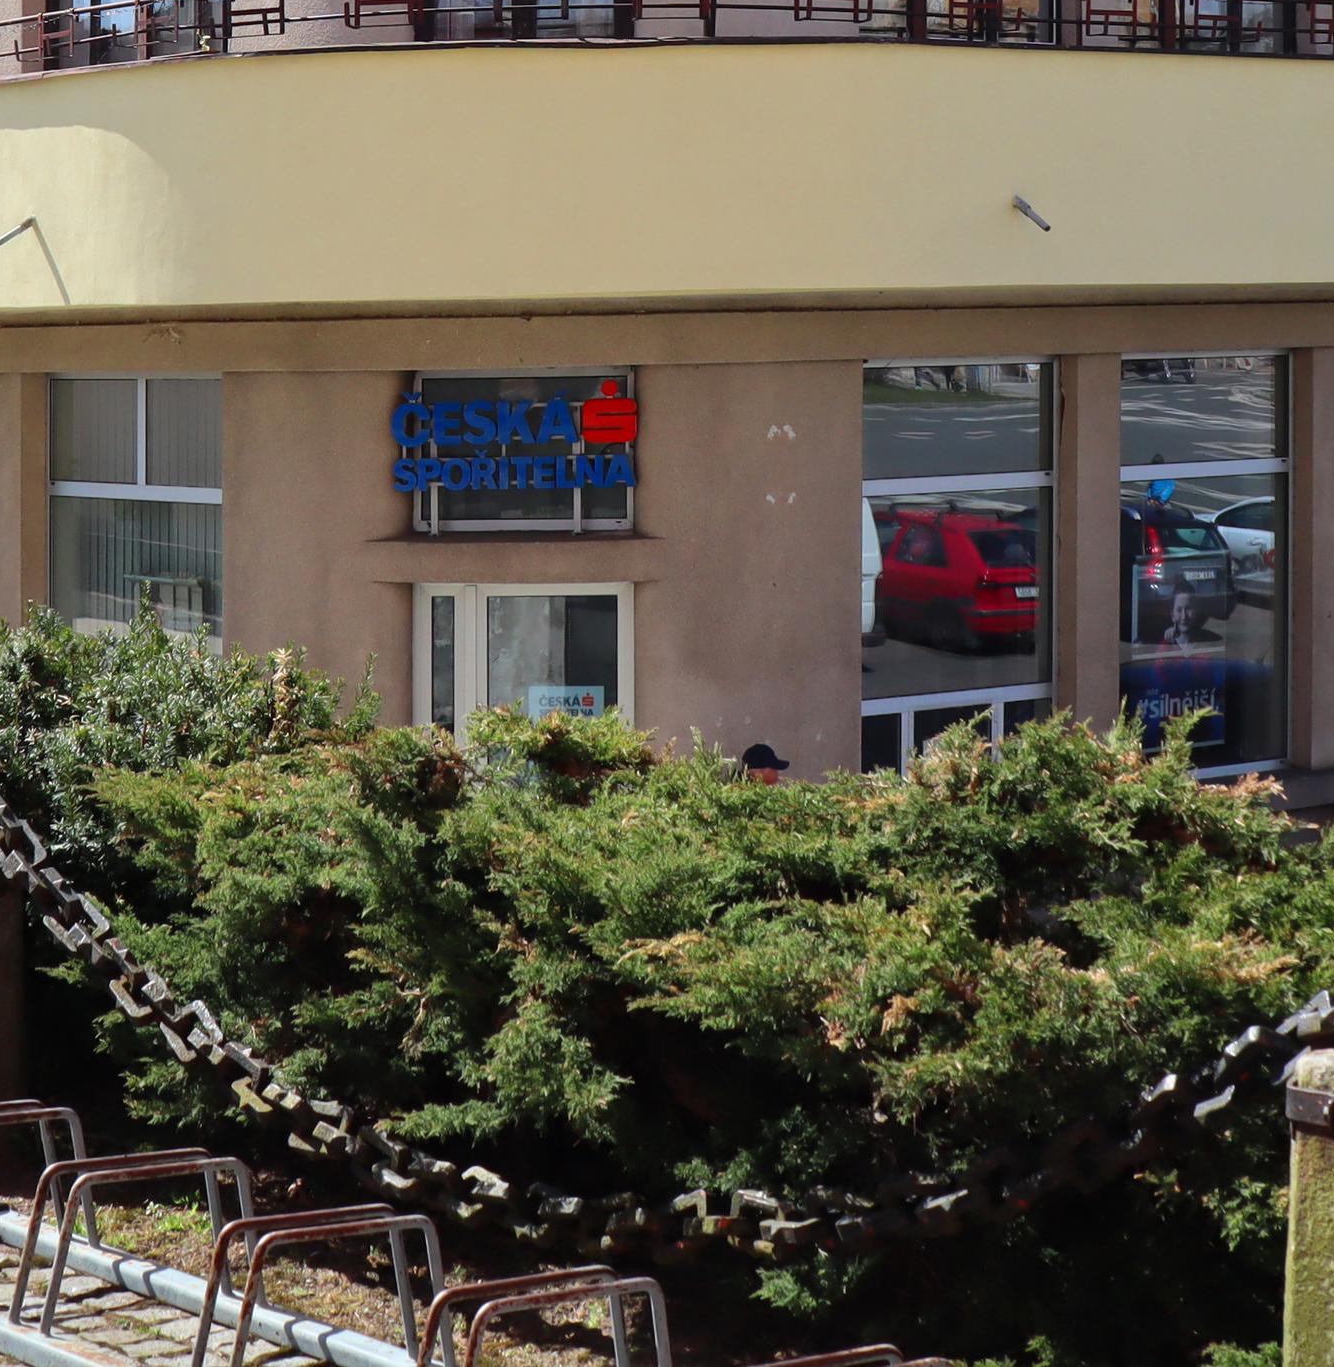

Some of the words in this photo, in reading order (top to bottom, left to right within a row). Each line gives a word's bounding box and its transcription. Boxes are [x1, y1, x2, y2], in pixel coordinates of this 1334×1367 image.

[391, 391, 580, 447] ČESKÁ
[393, 449, 636, 492] SPOŘITELNA
[539, 694, 581, 707] ČESKÁ
